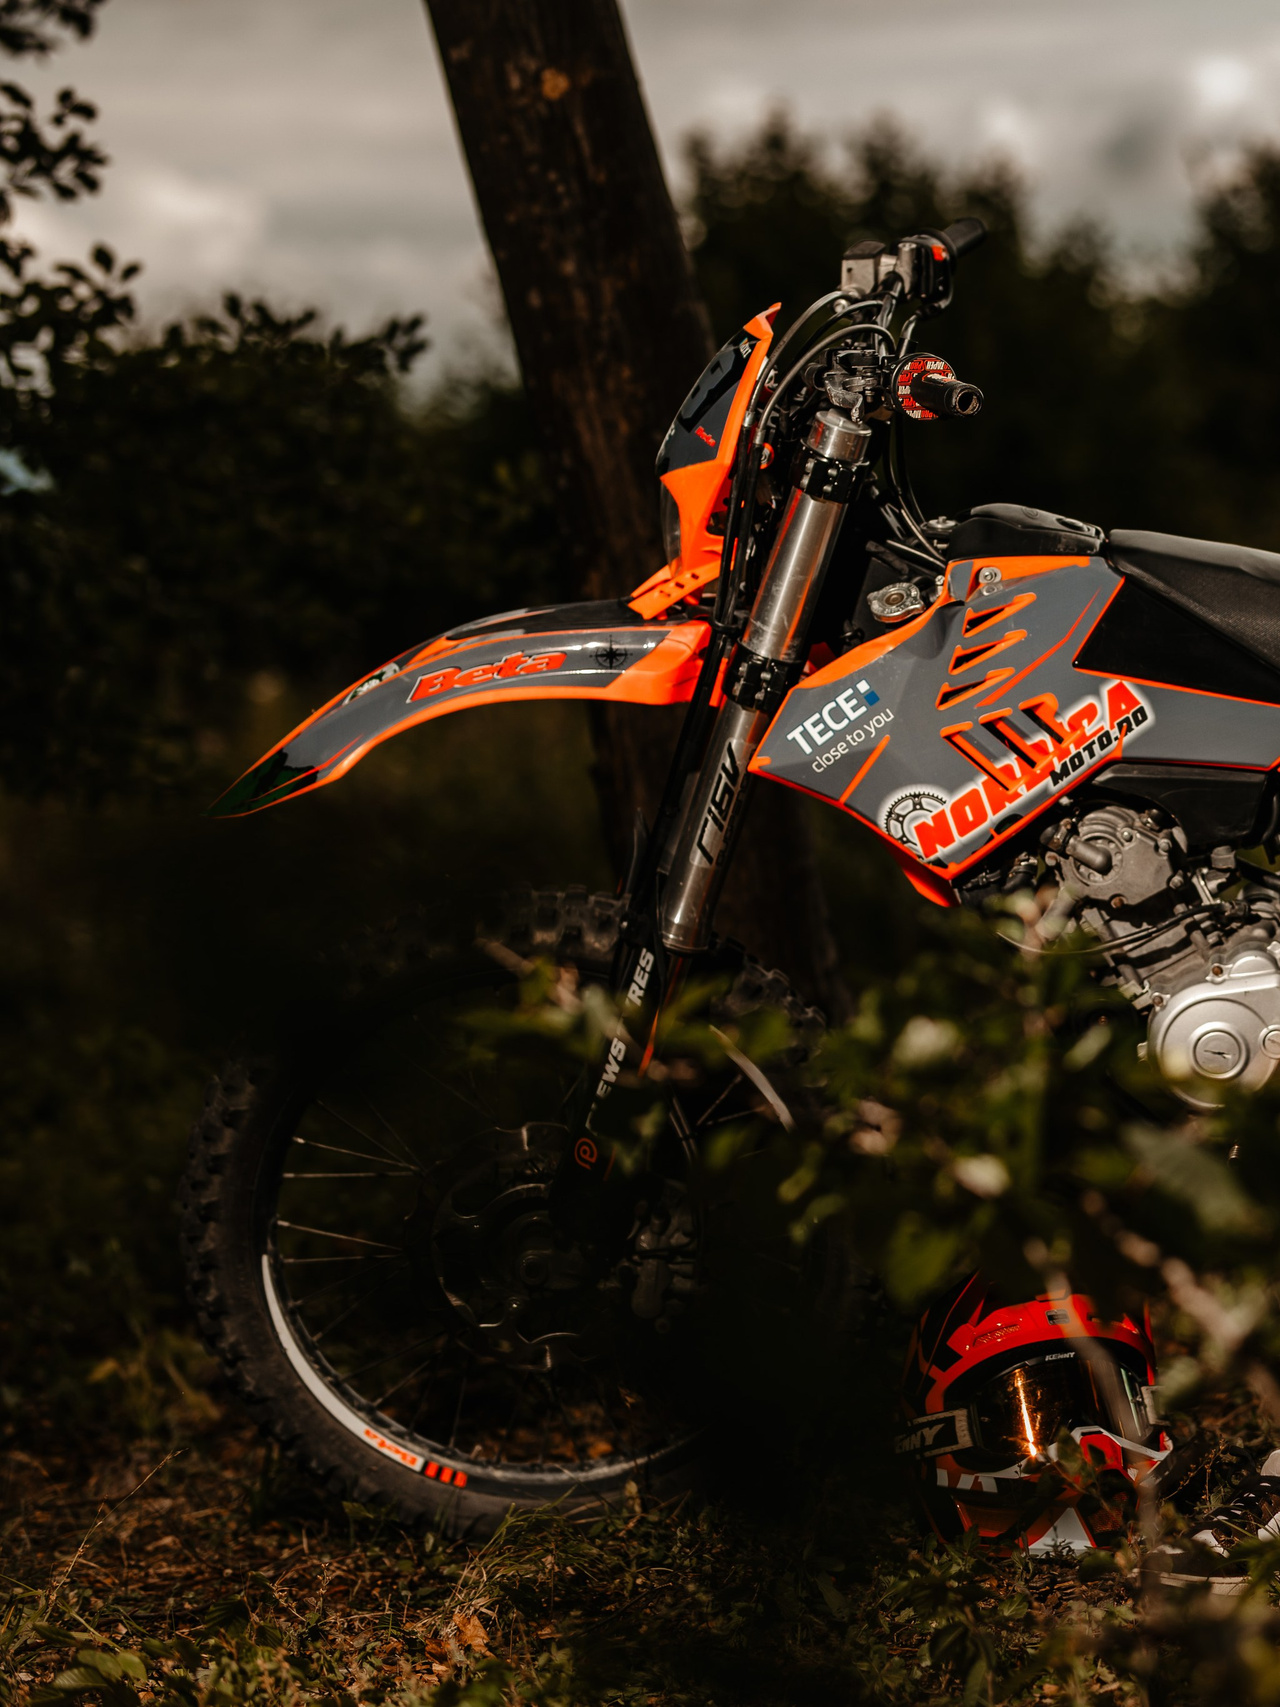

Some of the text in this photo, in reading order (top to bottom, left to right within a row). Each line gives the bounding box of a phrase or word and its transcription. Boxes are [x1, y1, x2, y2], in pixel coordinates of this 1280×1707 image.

[406, 650, 567, 704] Beta
[786, 687, 868, 755] TECE
[812, 708, 895, 773] close to you
[1045, 1351, 1075, 1361] KENNY
